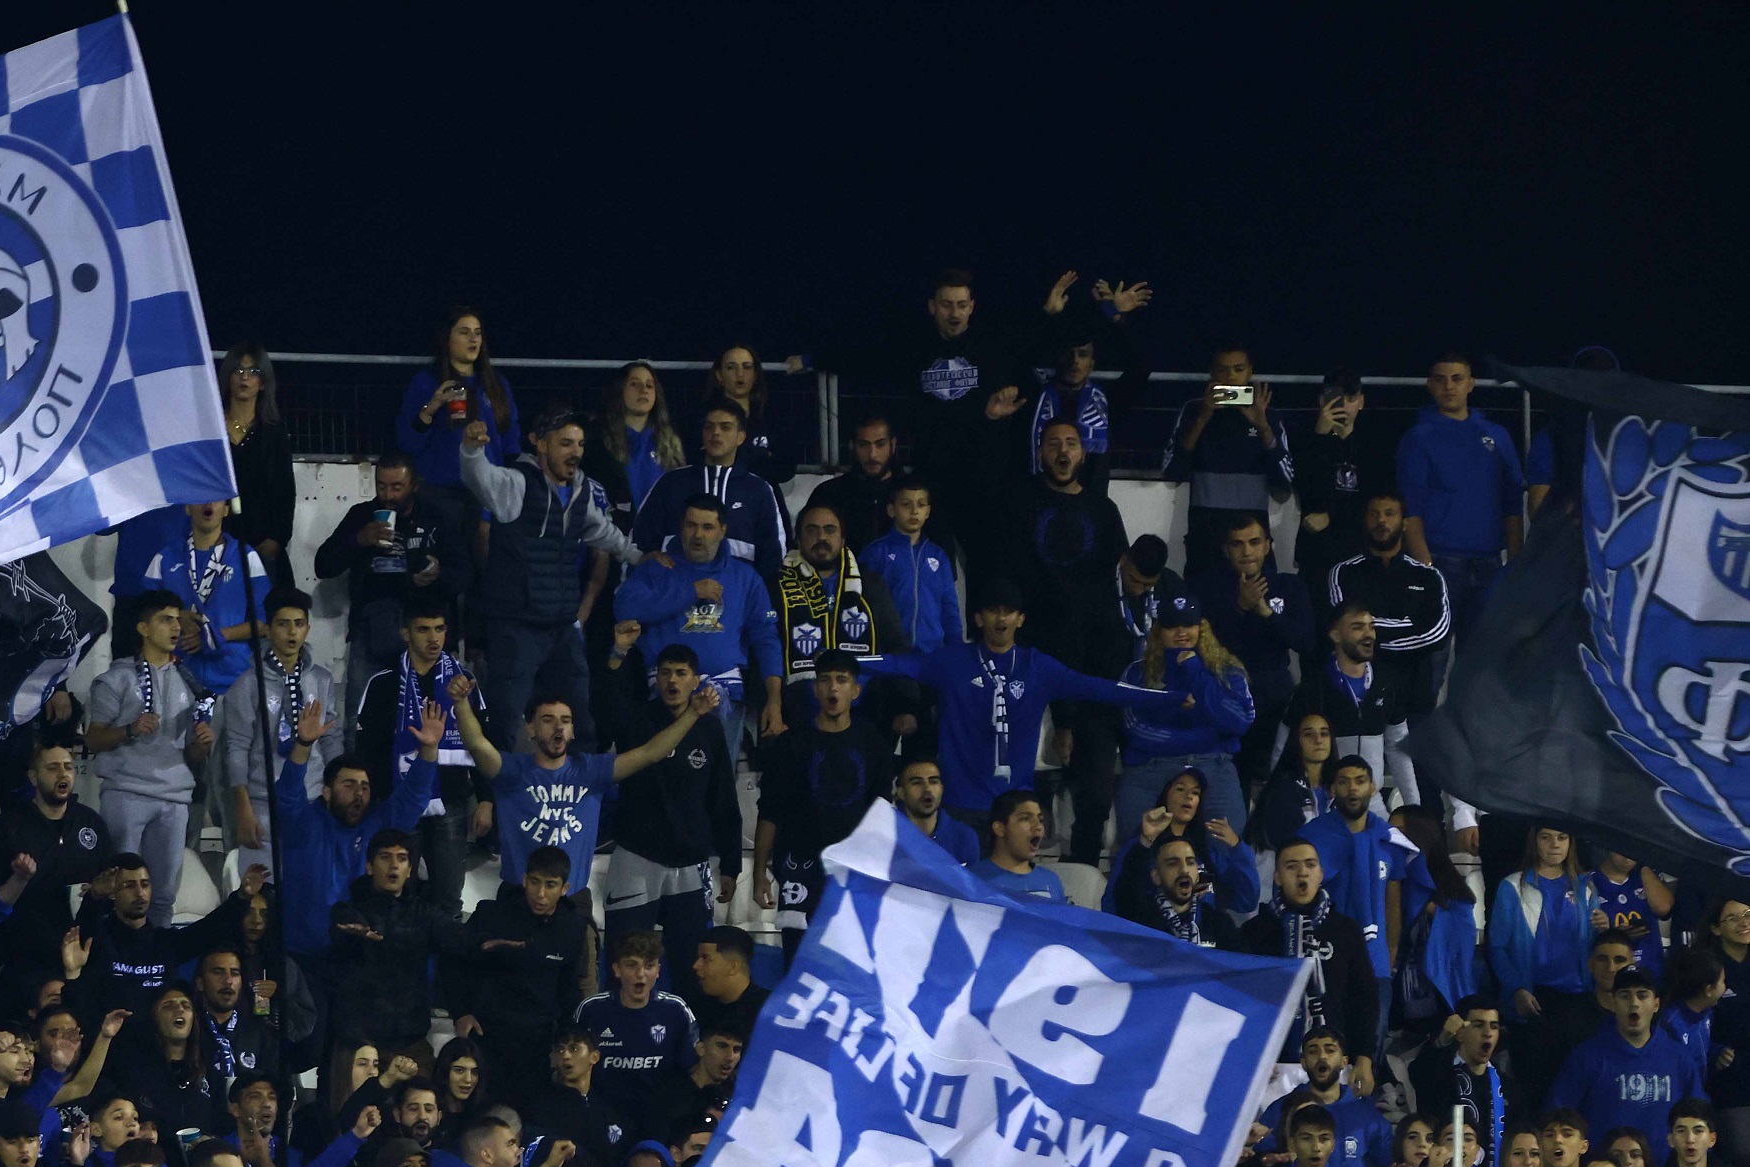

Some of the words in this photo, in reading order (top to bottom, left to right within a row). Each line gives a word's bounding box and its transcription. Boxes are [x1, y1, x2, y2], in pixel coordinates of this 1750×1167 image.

[526, 783, 590, 804] TOMMY
[539, 802, 575, 821] NYC
[520, 814, 584, 847] JEANS
[603, 1055, 664, 1070] FONBET
[1618, 1074, 1672, 1102] 1911
